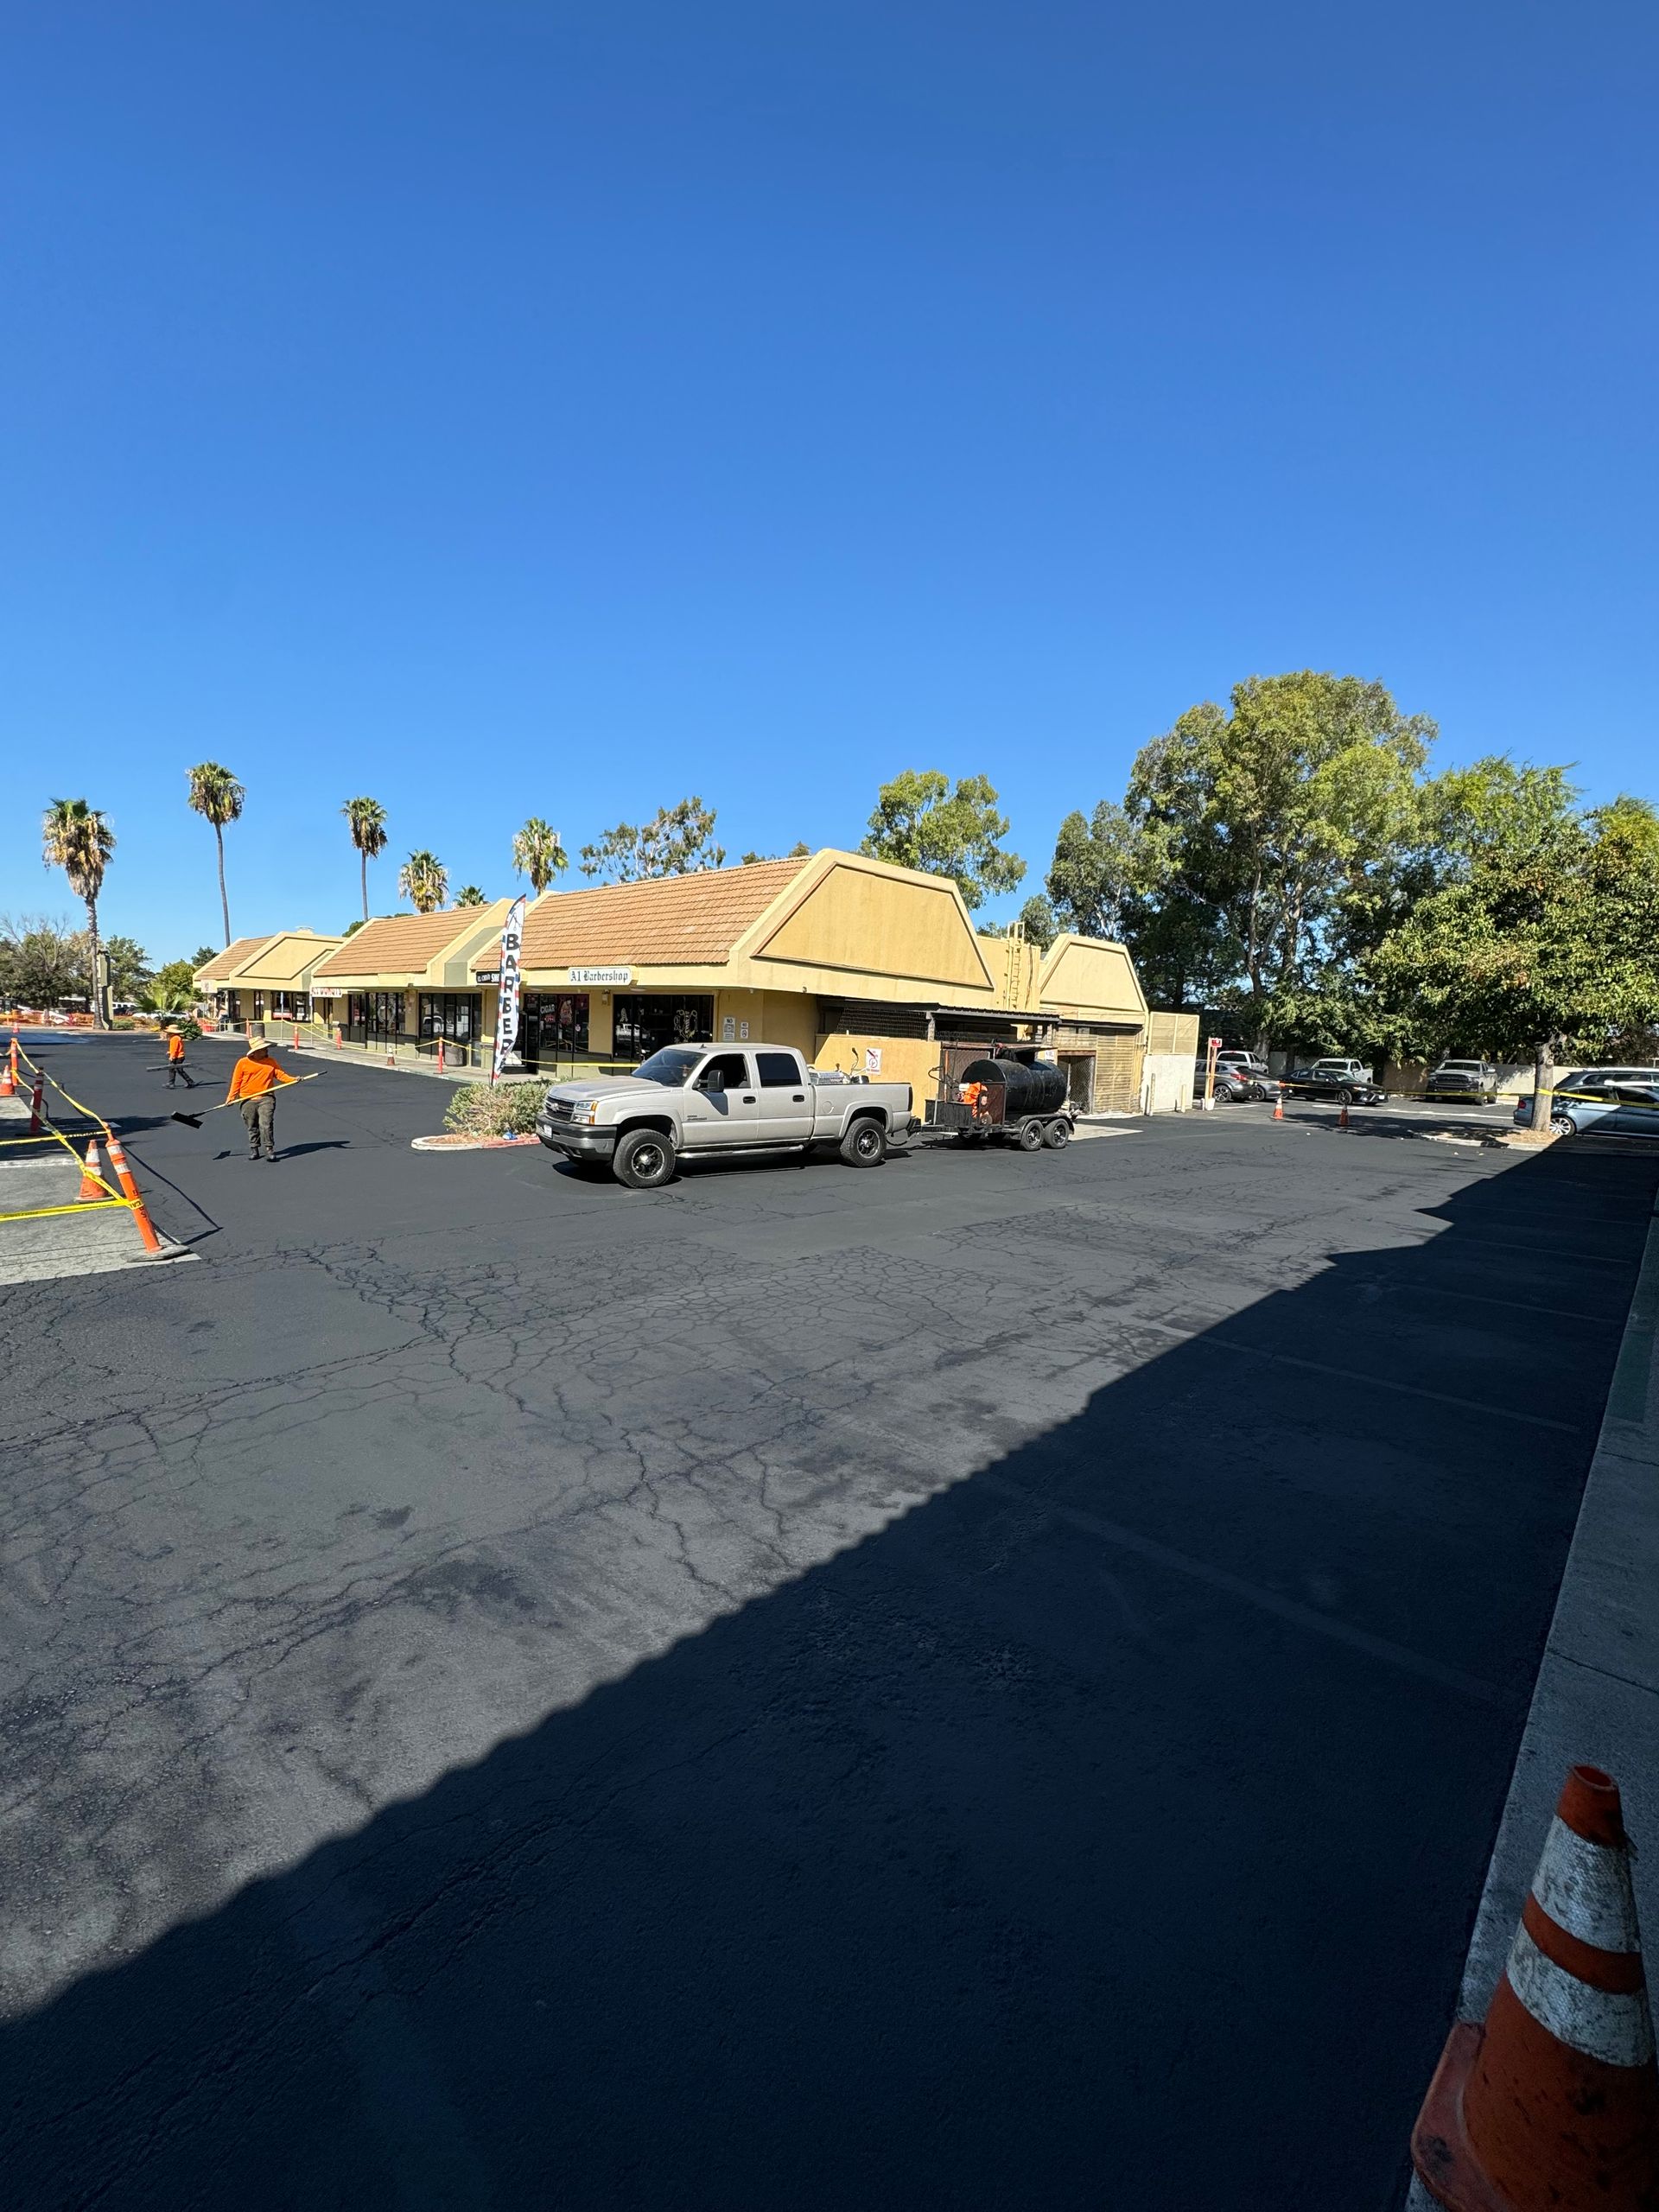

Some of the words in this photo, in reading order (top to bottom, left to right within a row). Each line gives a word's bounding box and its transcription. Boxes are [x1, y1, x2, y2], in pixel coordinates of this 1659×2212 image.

[500, 933, 520, 1055] BARBER
[570, 970, 582, 982] A1
[583, 970, 628, 982] Barbershop
